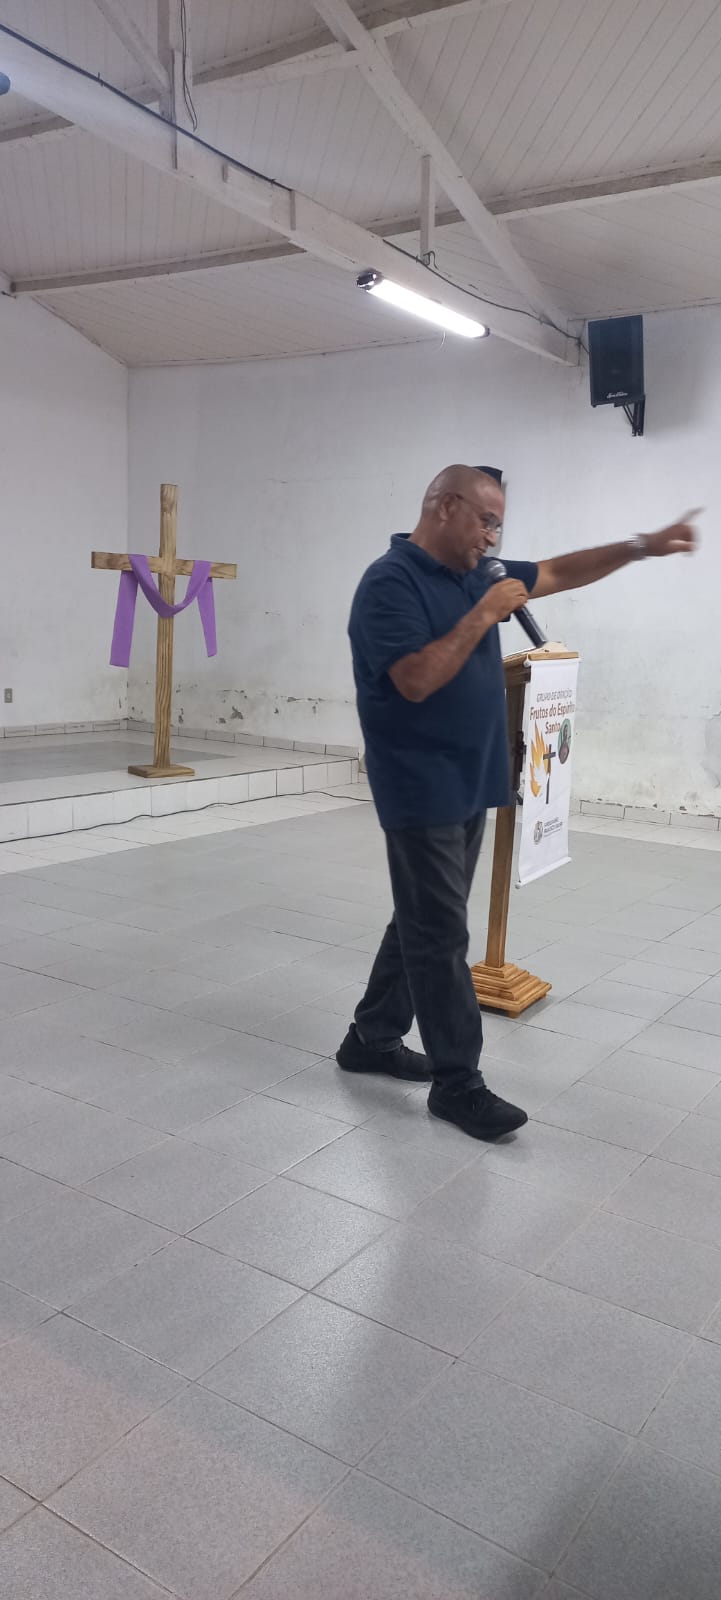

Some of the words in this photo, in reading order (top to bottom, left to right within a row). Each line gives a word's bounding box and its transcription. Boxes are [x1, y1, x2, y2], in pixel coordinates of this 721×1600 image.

[530, 707, 548, 720] Frutos
[549, 704, 556, 717] do
[545, 721, 560, 734] Santo
